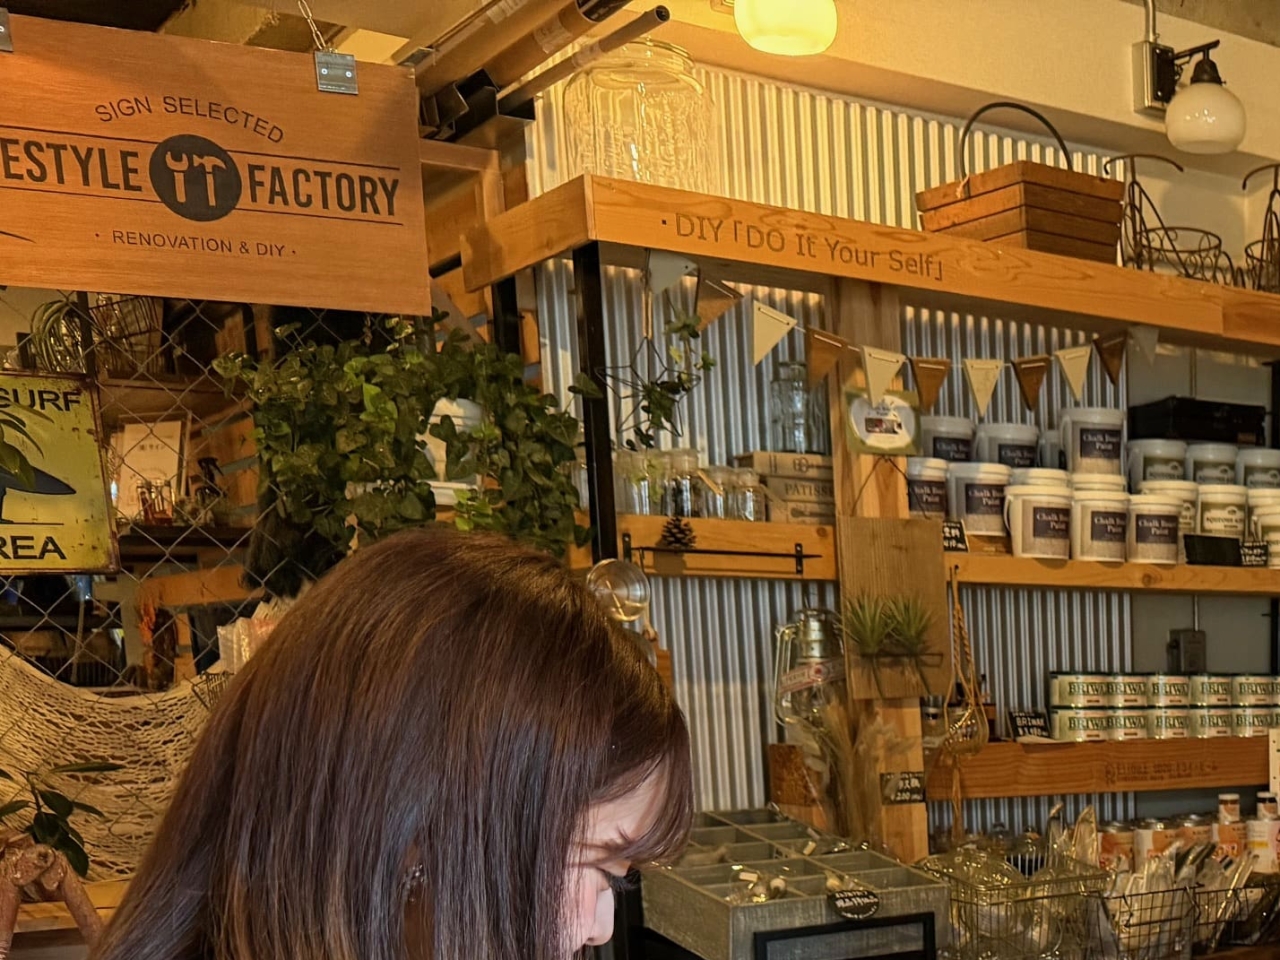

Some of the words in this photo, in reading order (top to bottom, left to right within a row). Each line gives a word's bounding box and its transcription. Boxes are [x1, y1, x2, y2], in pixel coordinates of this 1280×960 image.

[94, 96, 153, 122] SIGN
[163, 96, 284, 144] SELECTED
[248, 163, 400, 216] FACTORY
[112, 230, 232, 253] RENOVATION
[239, 241, 250, 254] &
[256, 242, 285, 257] DIY
[796, 232, 816, 258] It
[824, 237, 881, 268] Your
